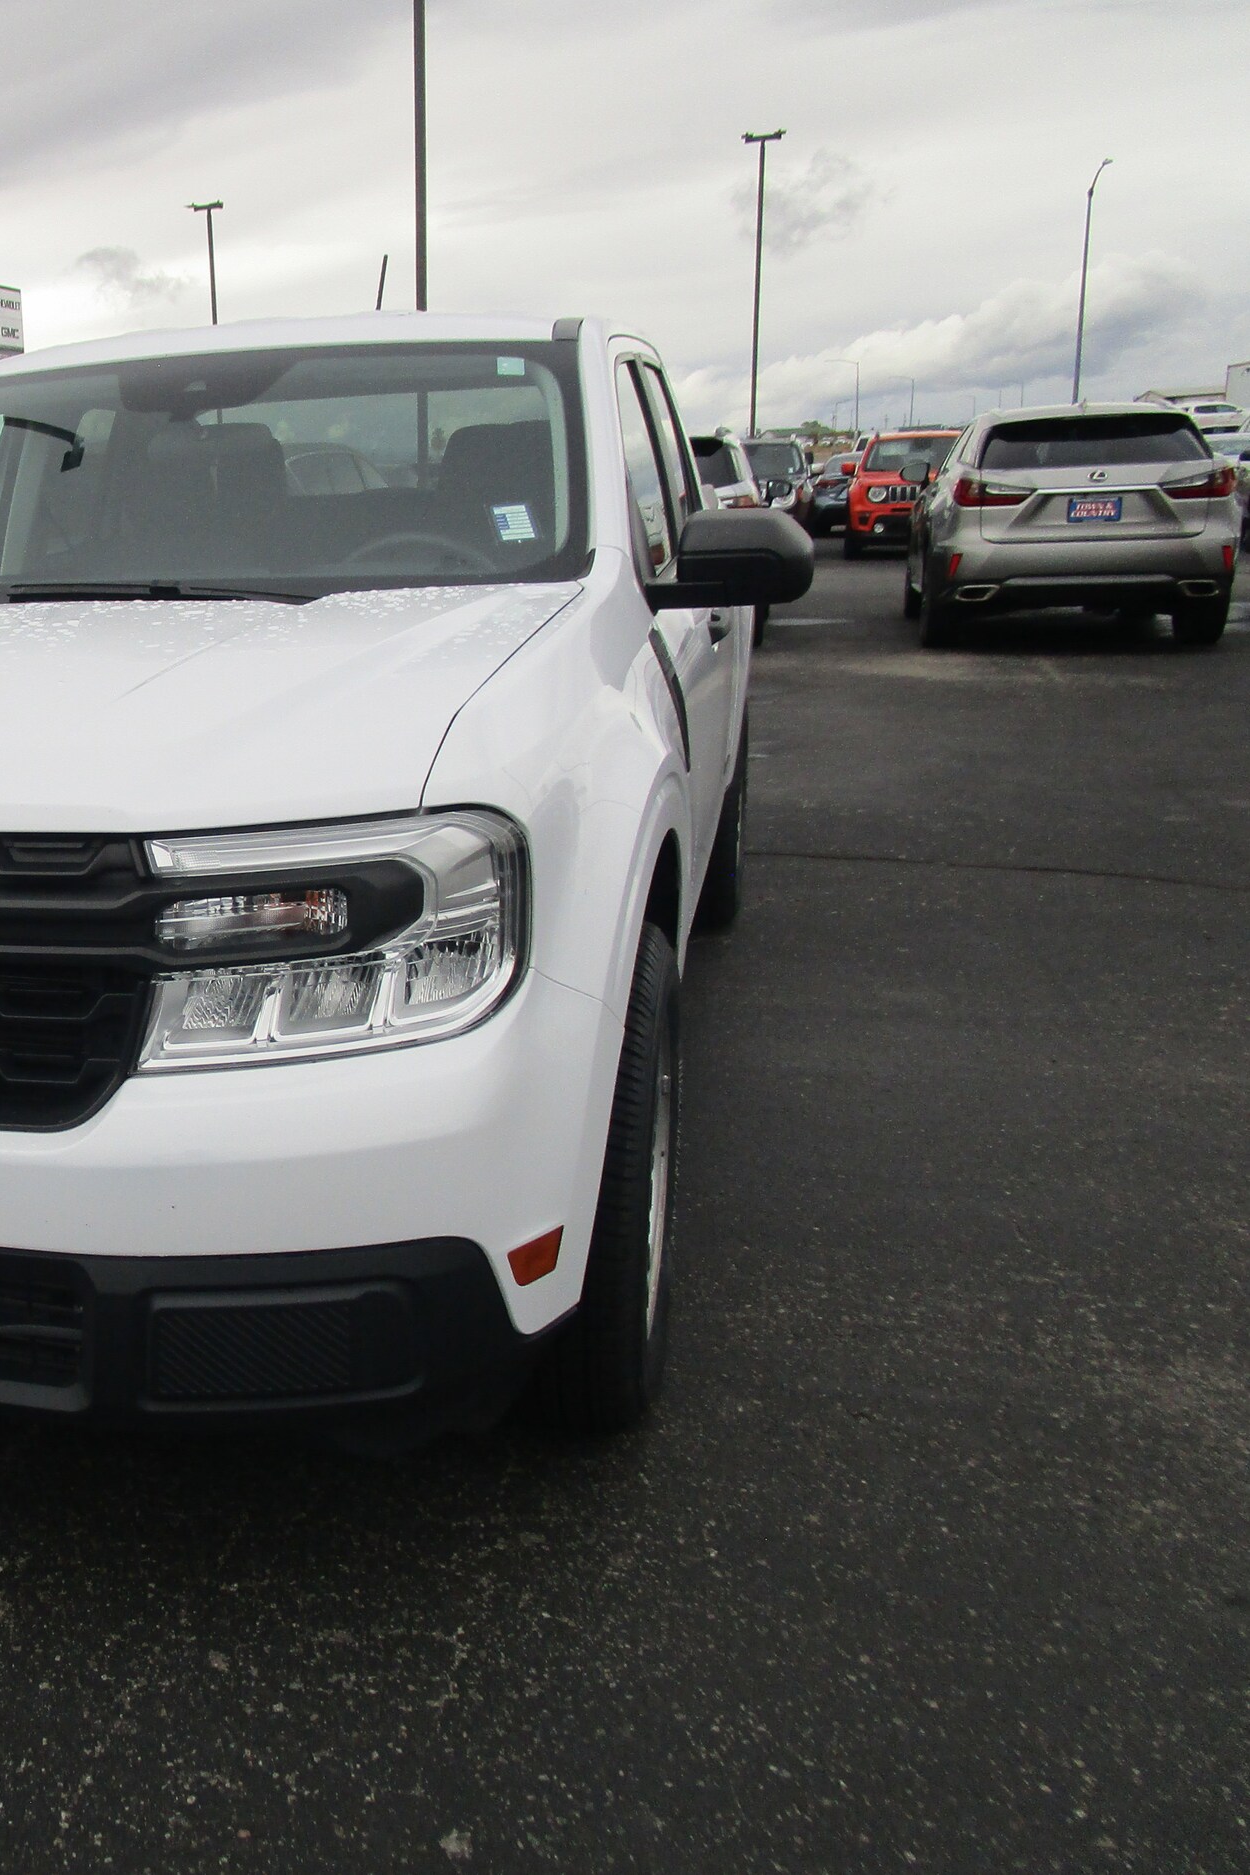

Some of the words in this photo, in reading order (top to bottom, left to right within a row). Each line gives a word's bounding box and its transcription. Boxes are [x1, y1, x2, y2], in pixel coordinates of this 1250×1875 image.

[1, 326, 20, 339] GMC
[1076, 502, 1104, 511] TOWN
[1070, 509, 1117, 517] COUNTRY
